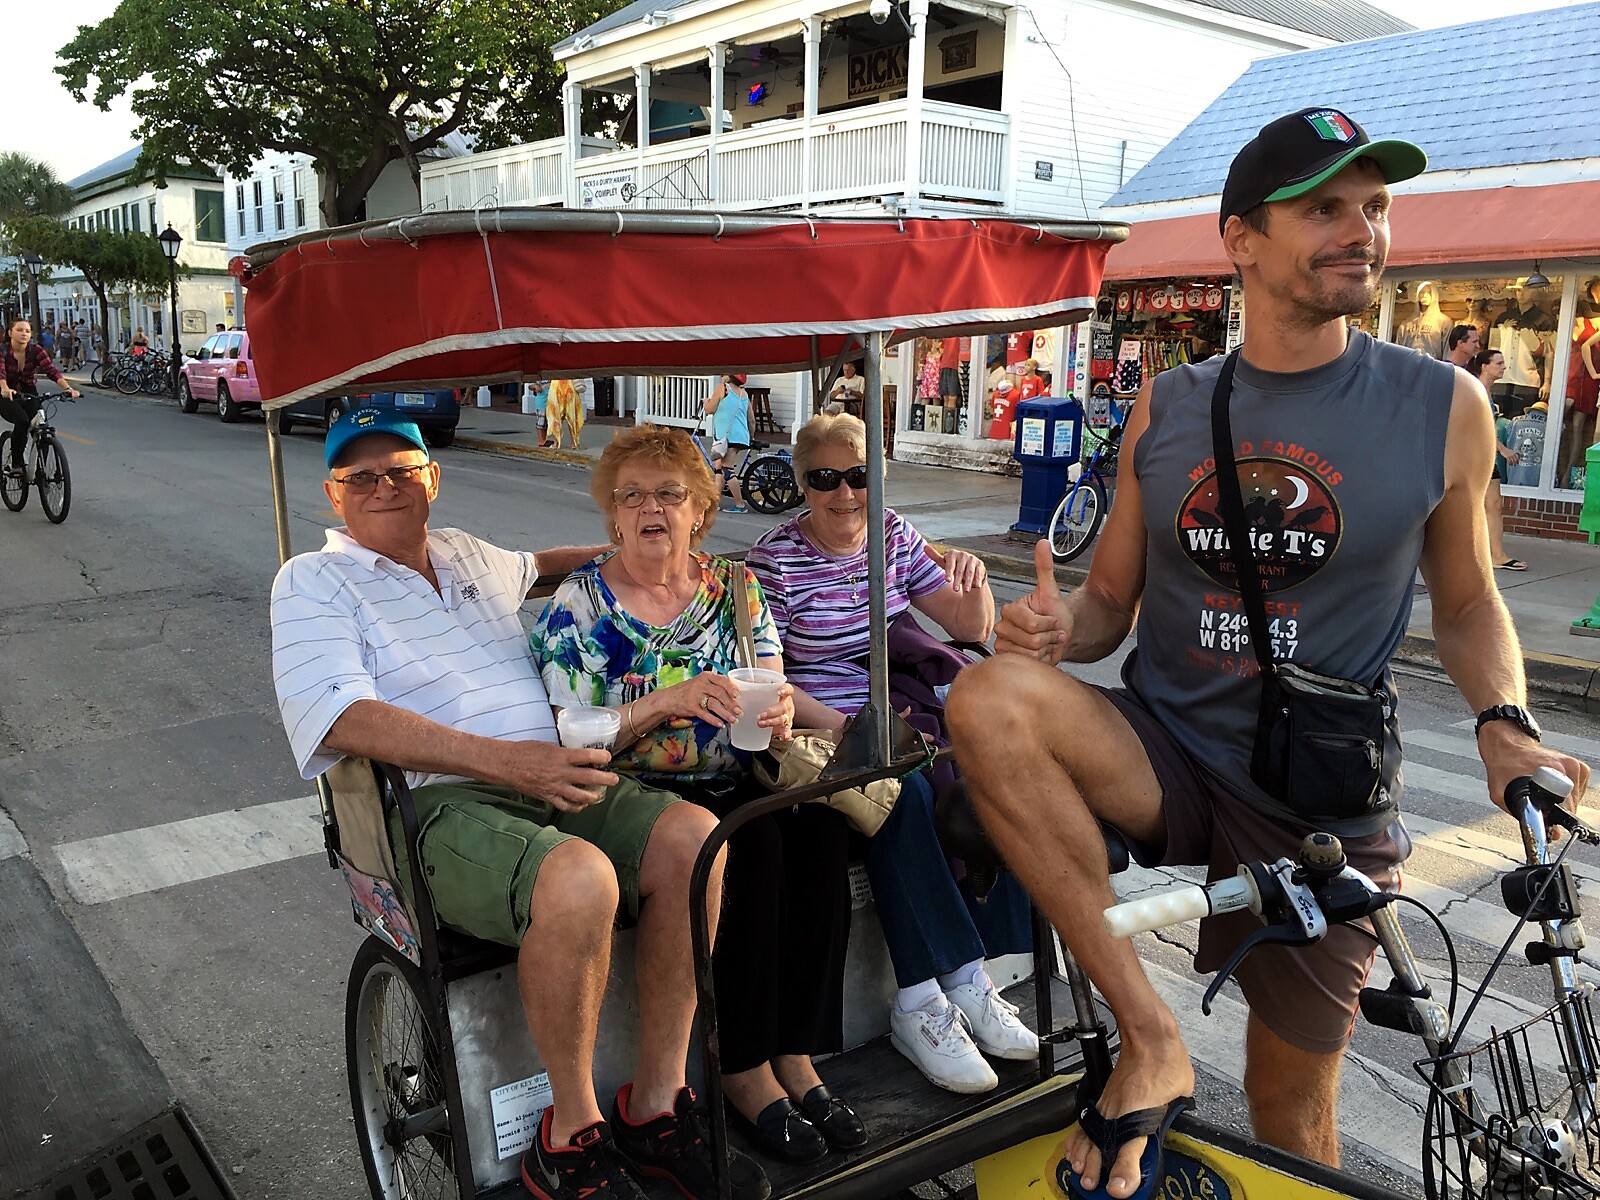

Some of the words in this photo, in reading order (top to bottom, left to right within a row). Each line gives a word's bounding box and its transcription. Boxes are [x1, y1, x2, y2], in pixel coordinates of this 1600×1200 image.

[1188, 441, 1254, 480] WOD
[1261, 442, 1343, 486] FAMOUS
[1283, 530, 1326, 557] T's
[1205, 594, 1242, 611] KEY
[1264, 601, 1302, 617] EST
[1200, 610, 1214, 629] N
[1200, 629, 1216, 649] W
[495, 1087, 510, 1097] CITY
[520, 1080, 533, 1088] KEY
[497, 1120, 512, 1128] Name:
